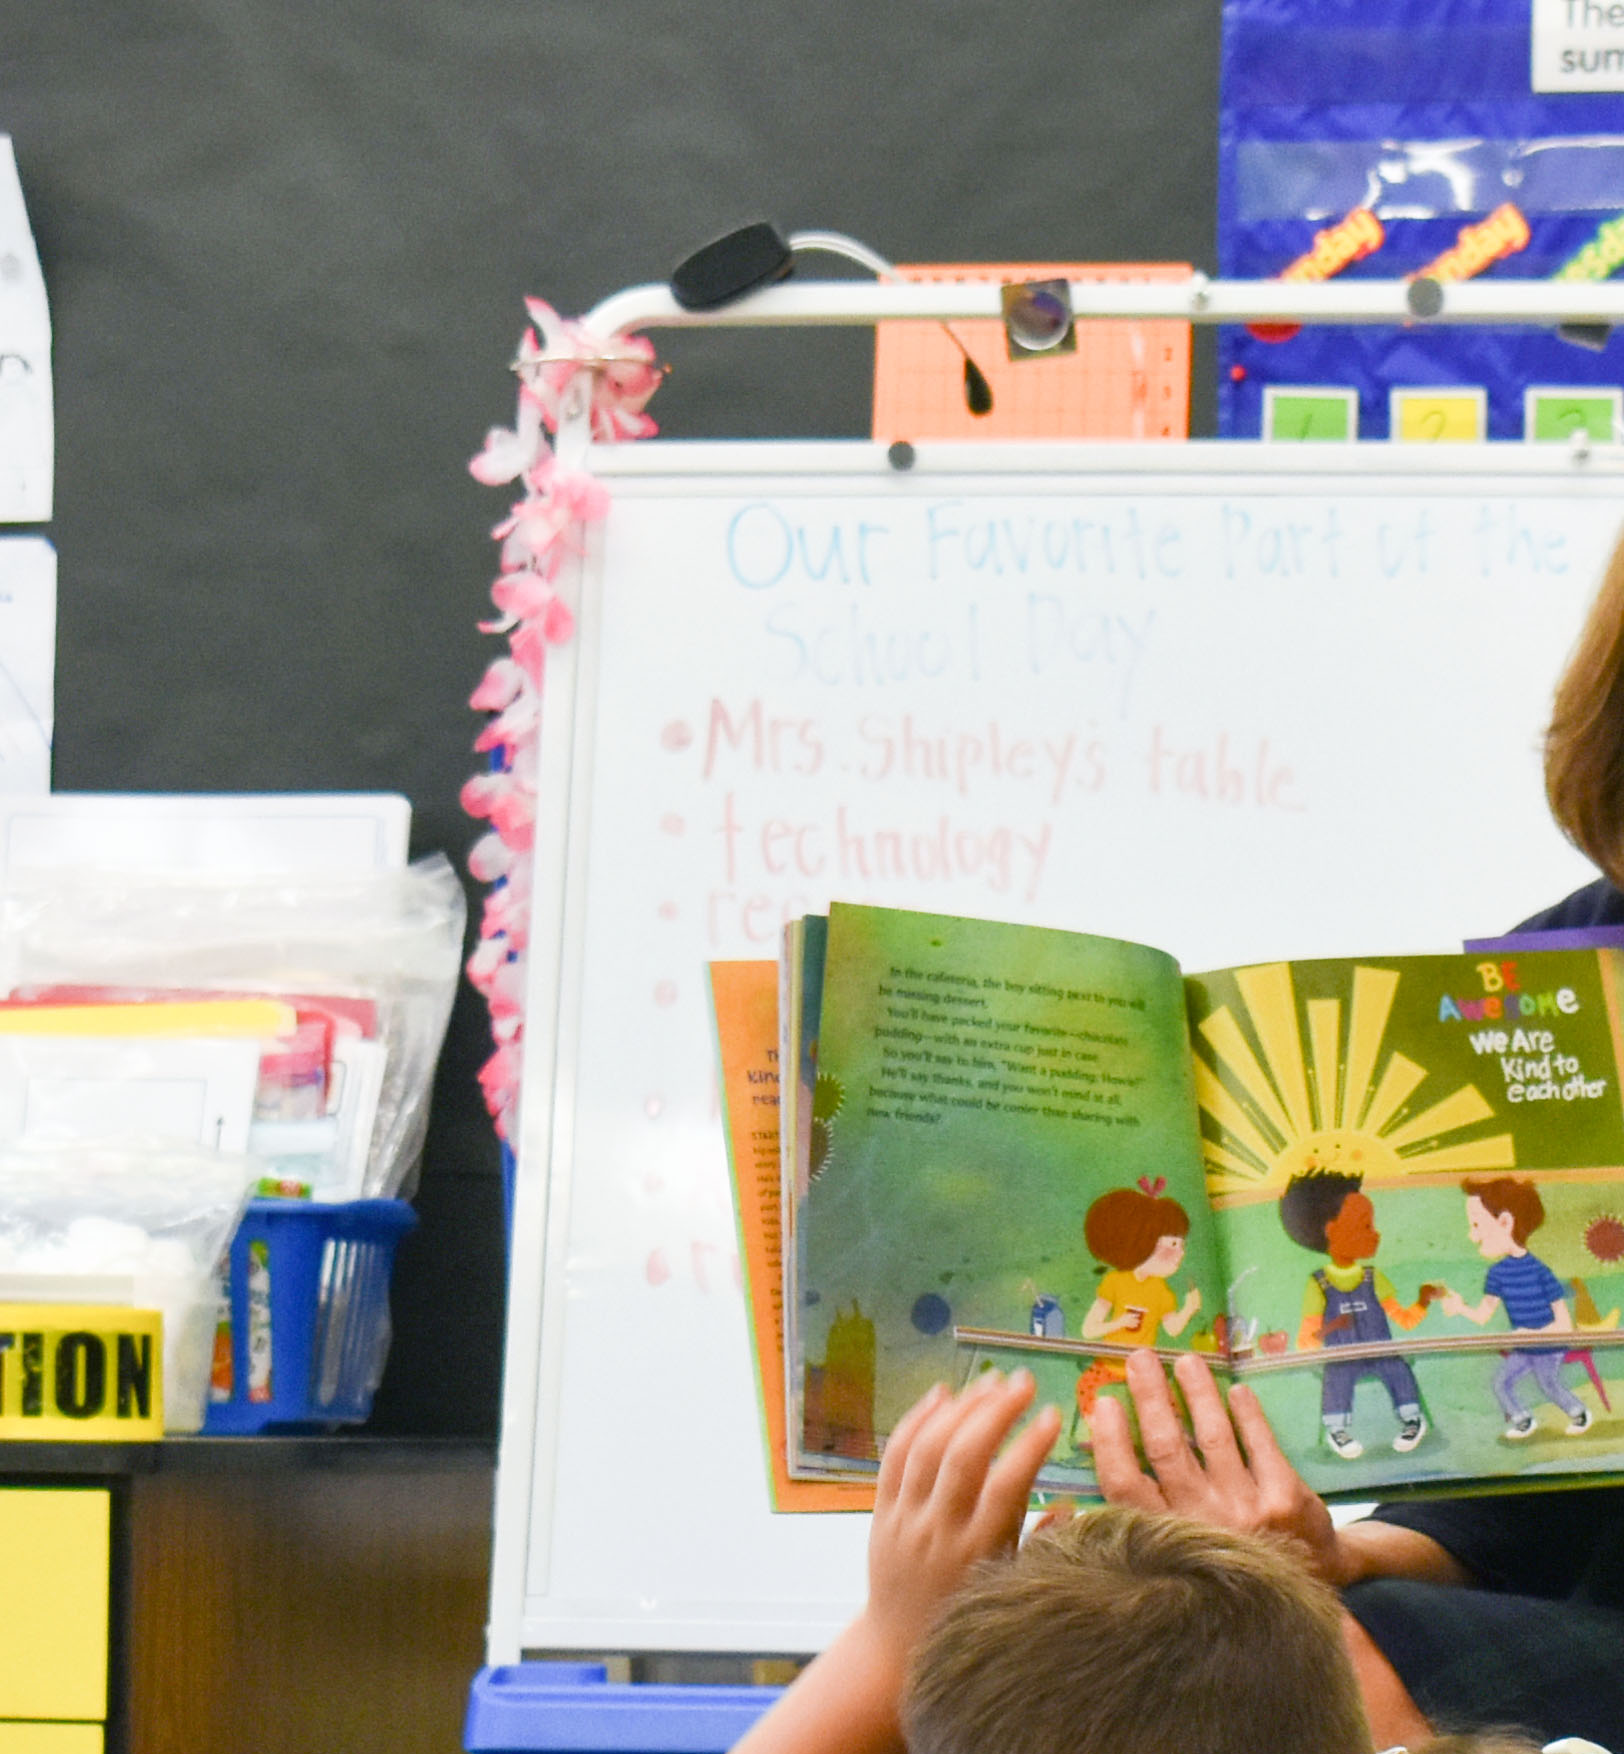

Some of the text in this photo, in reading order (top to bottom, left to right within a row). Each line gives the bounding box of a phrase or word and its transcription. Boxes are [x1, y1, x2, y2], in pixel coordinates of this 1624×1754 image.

[726, 501, 890, 591] Our
[926, 499, 1184, 581] Favorite
[1220, 502, 1344, 581] Part
[1474, 502, 1571, 578] the
[764, 590, 1157, 722] School Day
[702, 695, 1310, 813] Mrs. Shipley's table
[714, 790, 1054, 904] technology
[1476, 960, 1521, 992] BE
[1511, 1027, 1556, 1054] Are
[1554, 1053, 1580, 1076] to
[1561, 1075, 1608, 1101] other
